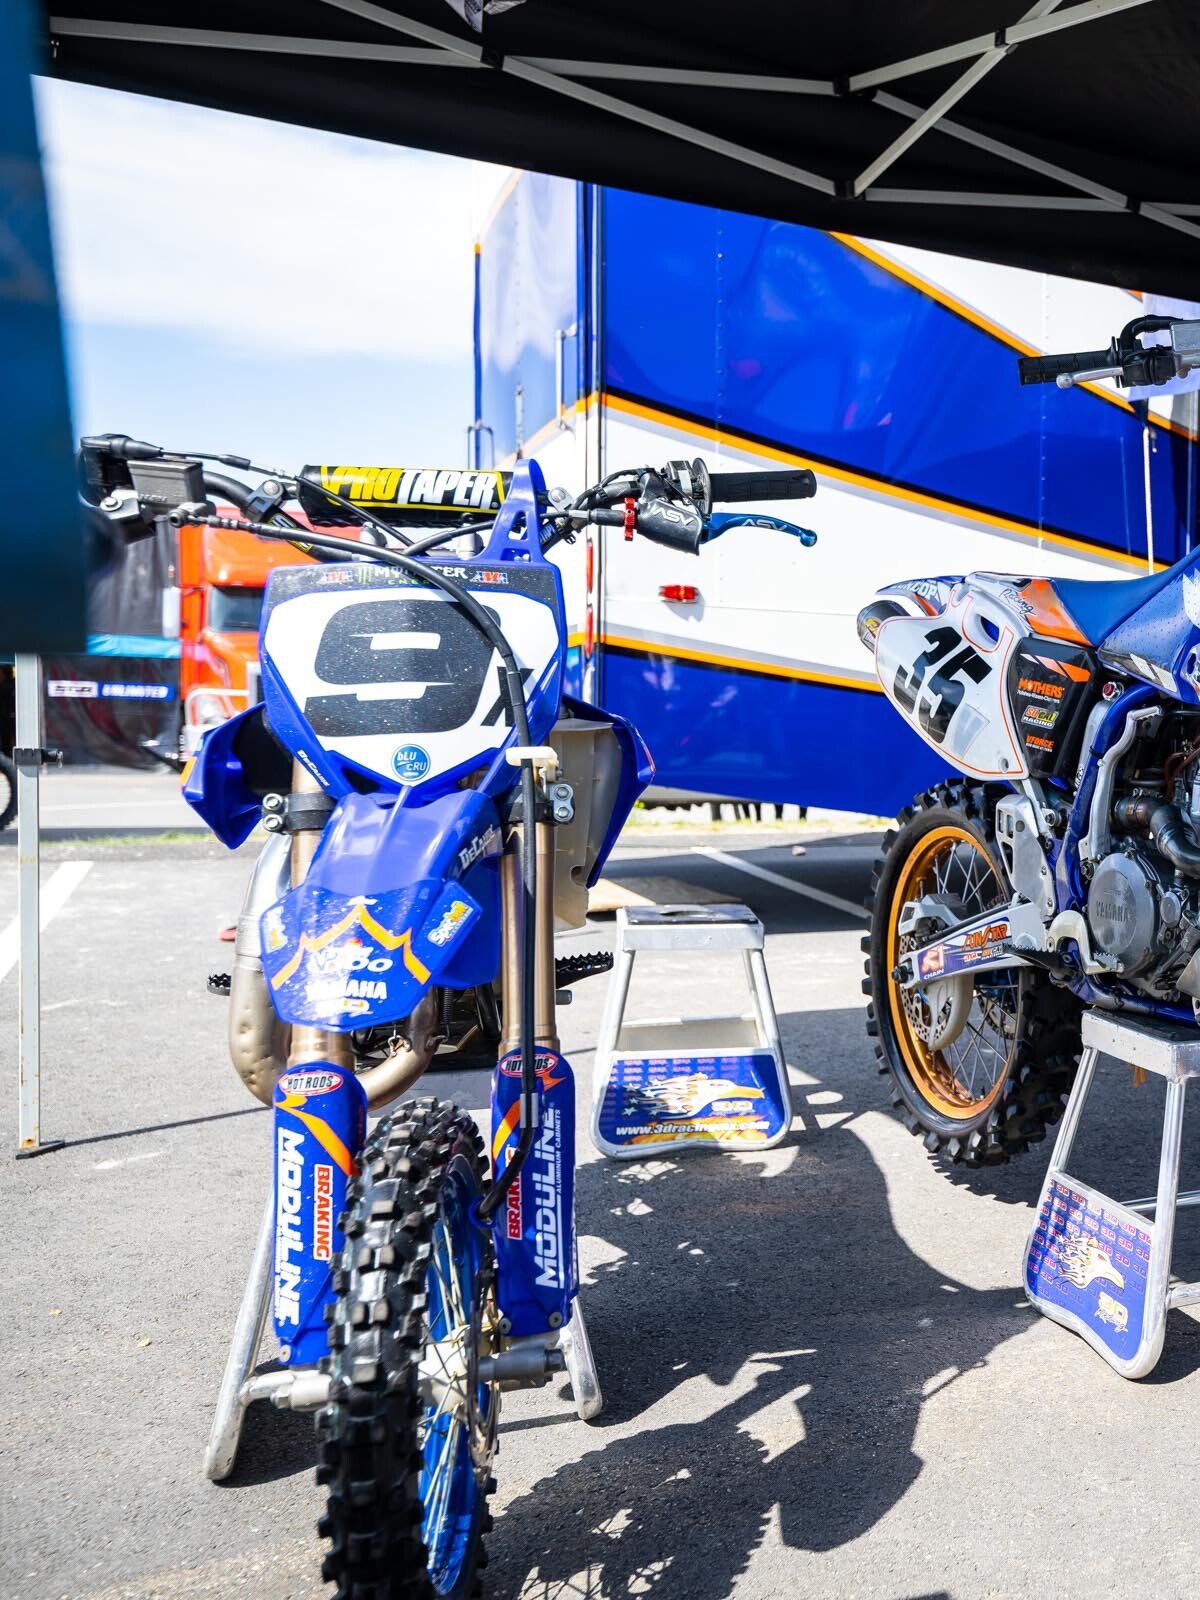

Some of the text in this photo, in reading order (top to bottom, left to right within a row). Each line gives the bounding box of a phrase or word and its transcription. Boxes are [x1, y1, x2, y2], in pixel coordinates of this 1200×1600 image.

[653, 509, 694, 527] ASV
[741, 518, 787, 531] ASV
[893, 626, 993, 744] 35
[1018, 678, 1063, 698] MOTHERS
[923, 968, 945, 980] CHAIN
[288, 1075, 333, 1090] HOT RODS
[533, 1103, 559, 1288] MODULINE
[316, 1165, 330, 1259] BRAKING
[281, 1129, 305, 1326] MODULINE
